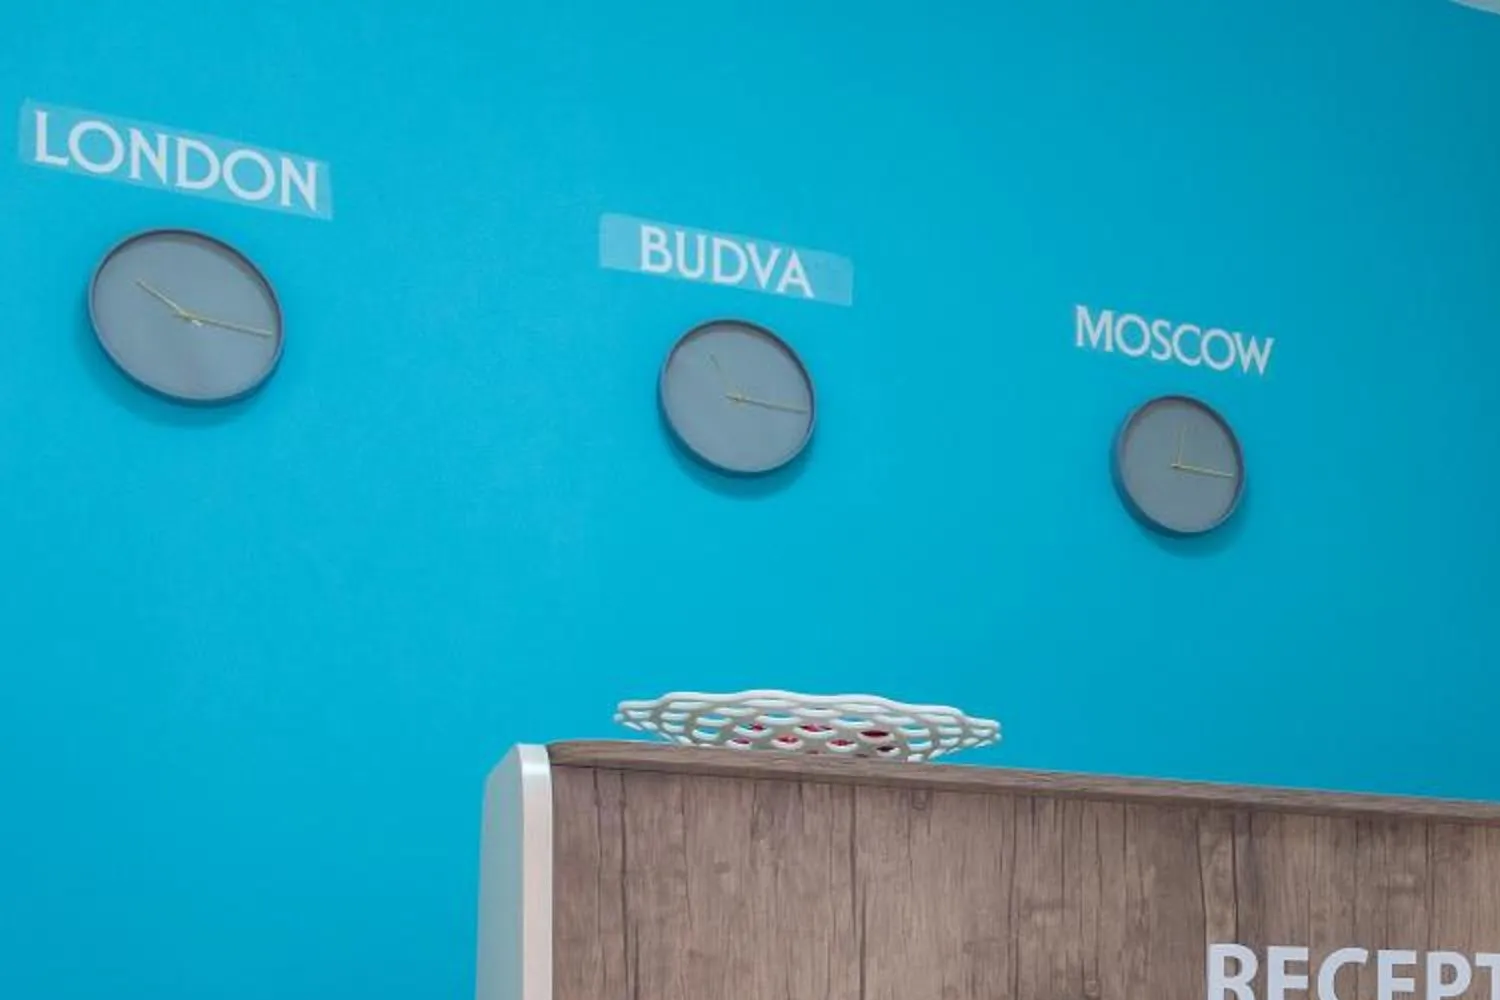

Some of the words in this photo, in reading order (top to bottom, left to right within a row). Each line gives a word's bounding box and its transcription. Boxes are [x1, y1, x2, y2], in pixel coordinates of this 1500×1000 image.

[34, 110, 319, 211] LONDON
[640, 224, 815, 298] BUDVA
[1075, 304, 1275, 376] MOSCOW
